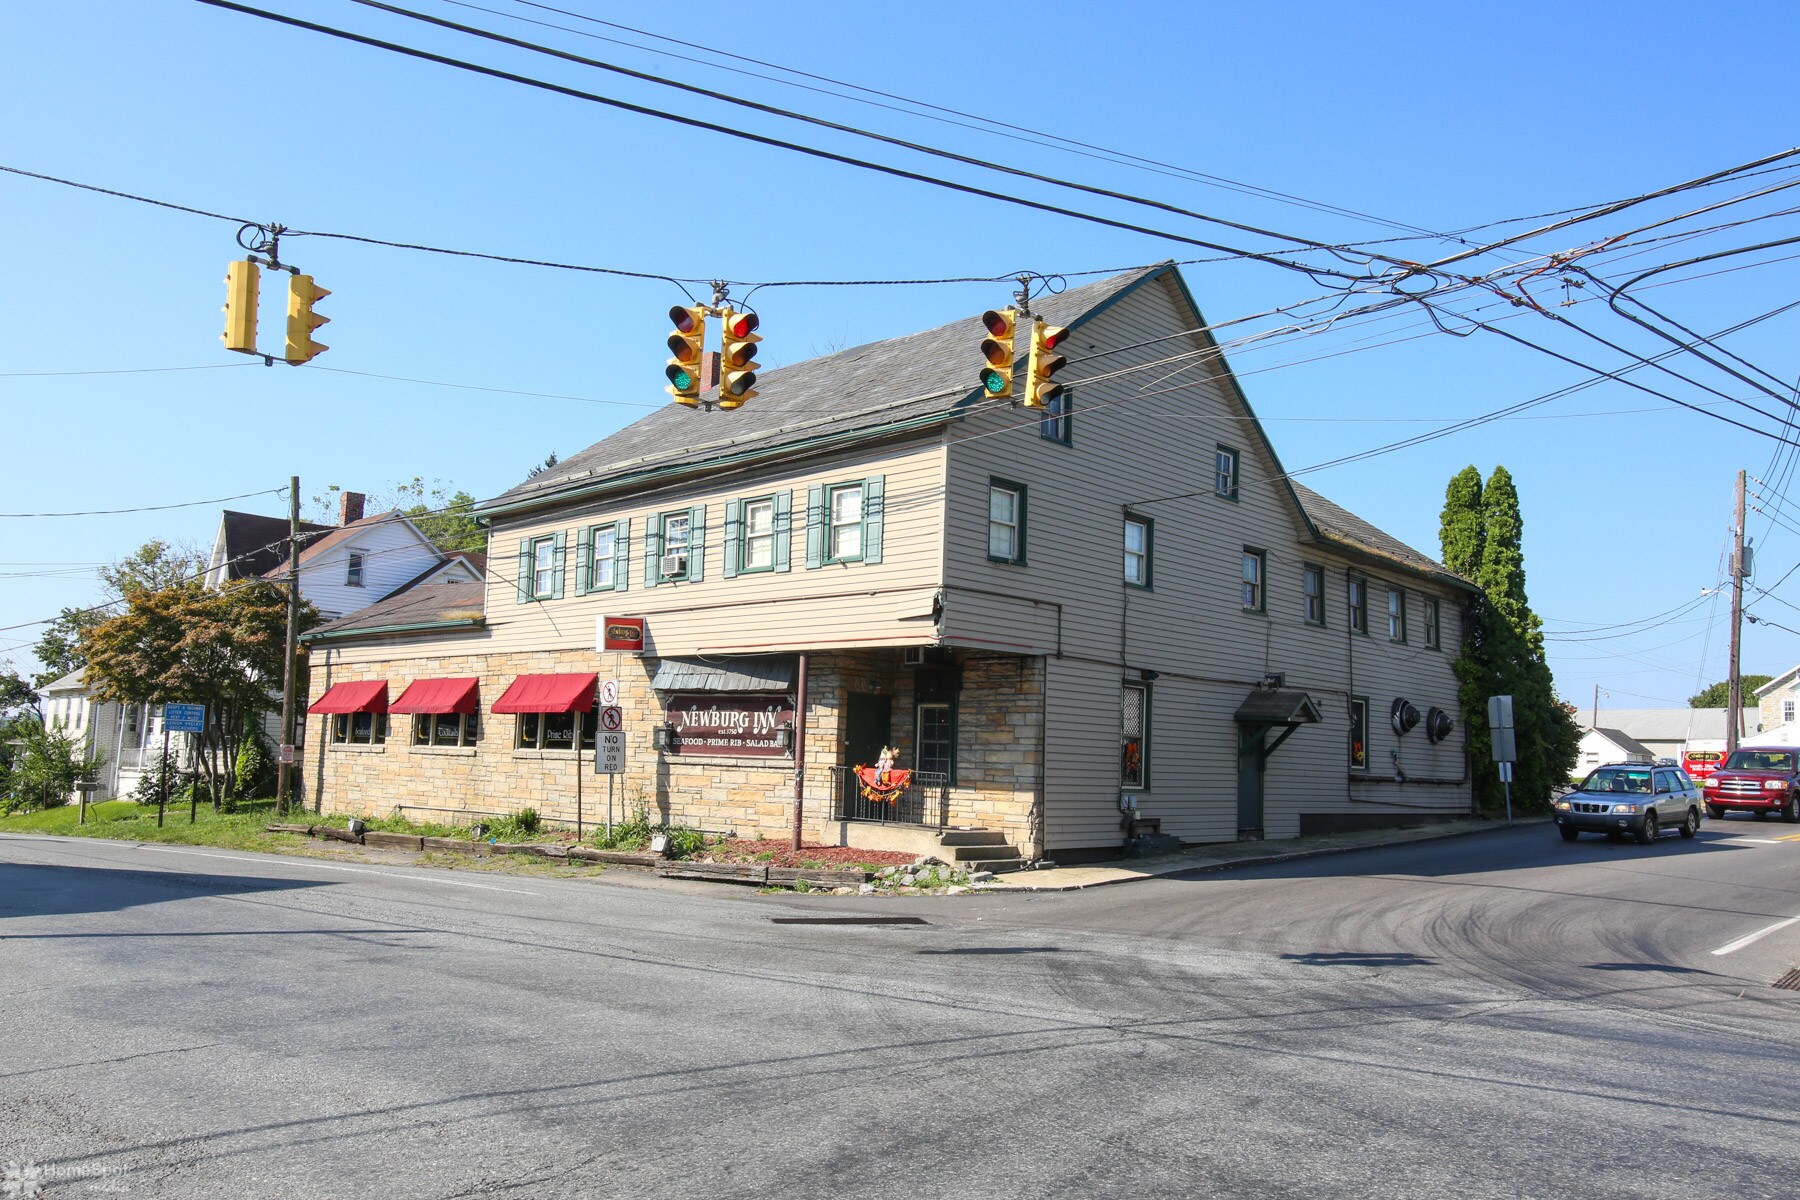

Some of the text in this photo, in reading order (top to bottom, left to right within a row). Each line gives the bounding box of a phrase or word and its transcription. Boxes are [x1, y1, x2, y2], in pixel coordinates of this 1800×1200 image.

[676, 704, 782, 735] NEWBURG INN
[604, 735, 619, 744] NO
[672, 737, 783, 748] SEAFOOD PRIME RIB SALAD BA
[602, 745, 621, 753] TURN
[606, 754, 617, 762] ON
[604, 763, 618, 771] RED
